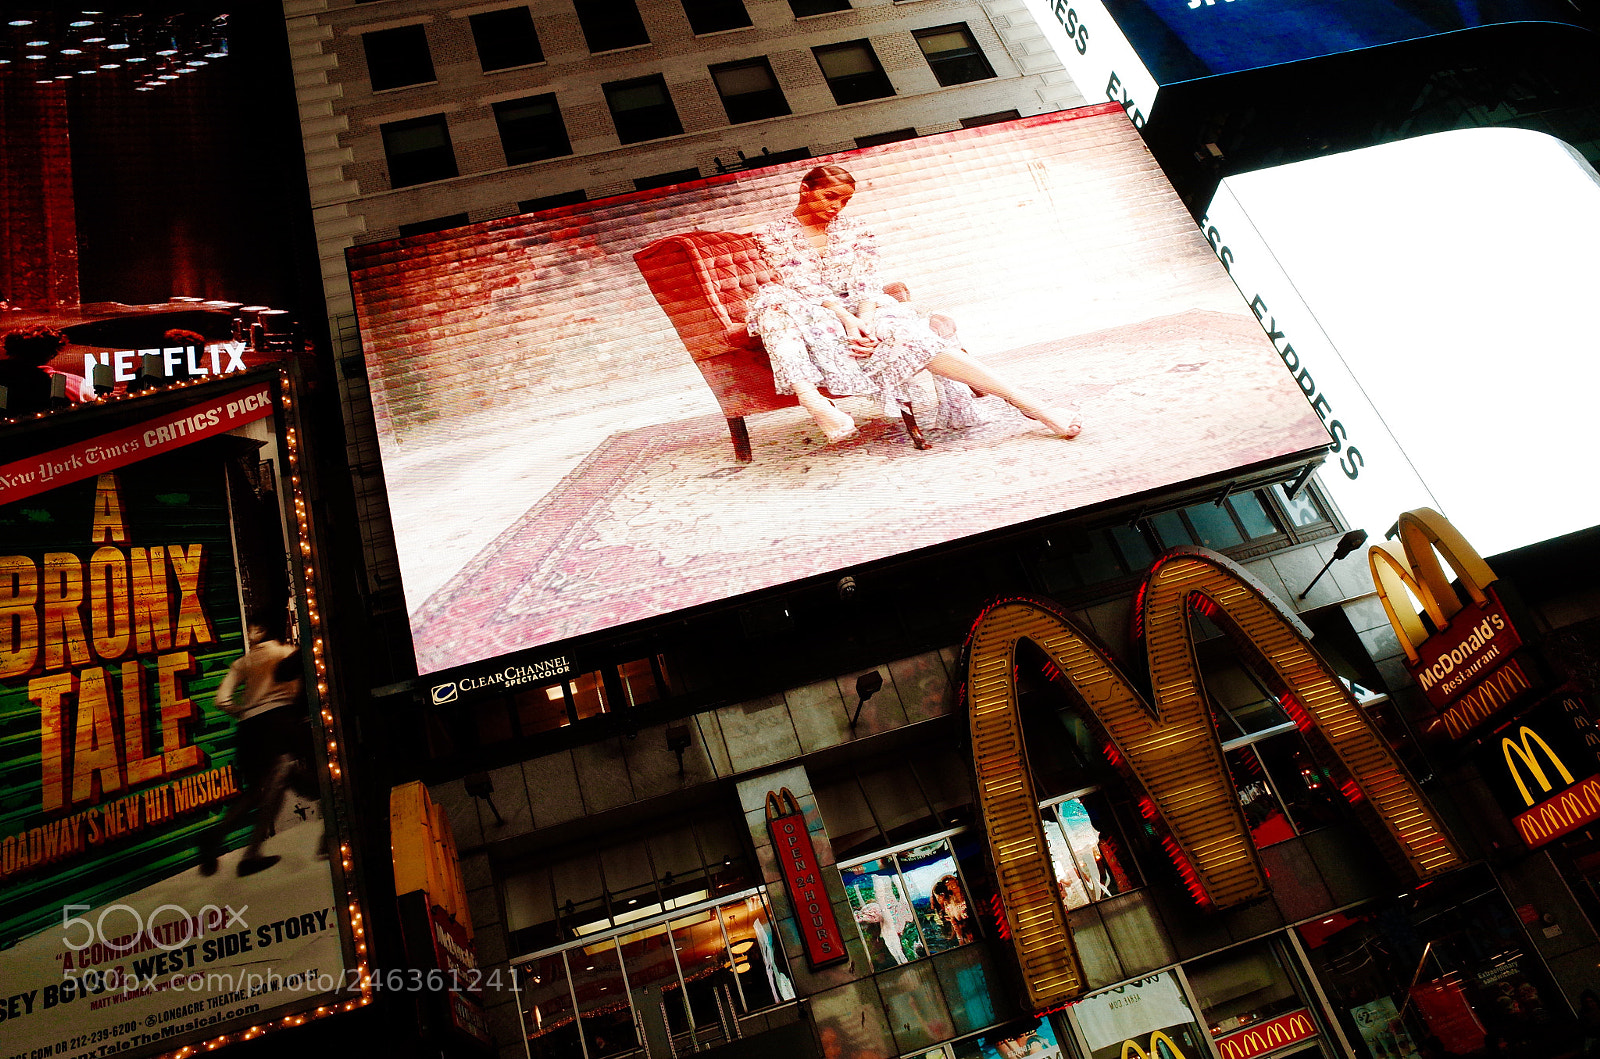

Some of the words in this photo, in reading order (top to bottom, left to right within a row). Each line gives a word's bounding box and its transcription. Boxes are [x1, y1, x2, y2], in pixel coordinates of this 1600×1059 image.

[1046, 0, 1089, 55] ESS
[0, 471, 35, 491] New
[39, 454, 83, 482] York
[86, 438, 139, 464] Times
[226, 390, 272, 419] PICK
[92, 471, 126, 543] A
[0, 543, 217, 678] BRONX
[504, 665, 570, 688] SPECTACOLOR
[1418, 613, 1505, 692] McDonald's
[1441, 644, 1501, 695] Restaurant
[28, 651, 199, 813] TALE
[103, 794, 141, 839] NEW
[144, 784, 170, 824] HIT
[173, 764, 238, 813] MUSICAL
[43, 970, 106, 1009] BOYS
[132, 944, 198, 982] WEST
[202, 930, 252, 963] SIDE
[80, 914, 205, 969] COMBINATION
[55, 1041, 68, 1055] OR
[70, 1020, 137, 1049] 212-239-6200
[158, 1000, 204, 1024] LONGACRE
[90, 996, 111, 1011] MATT
